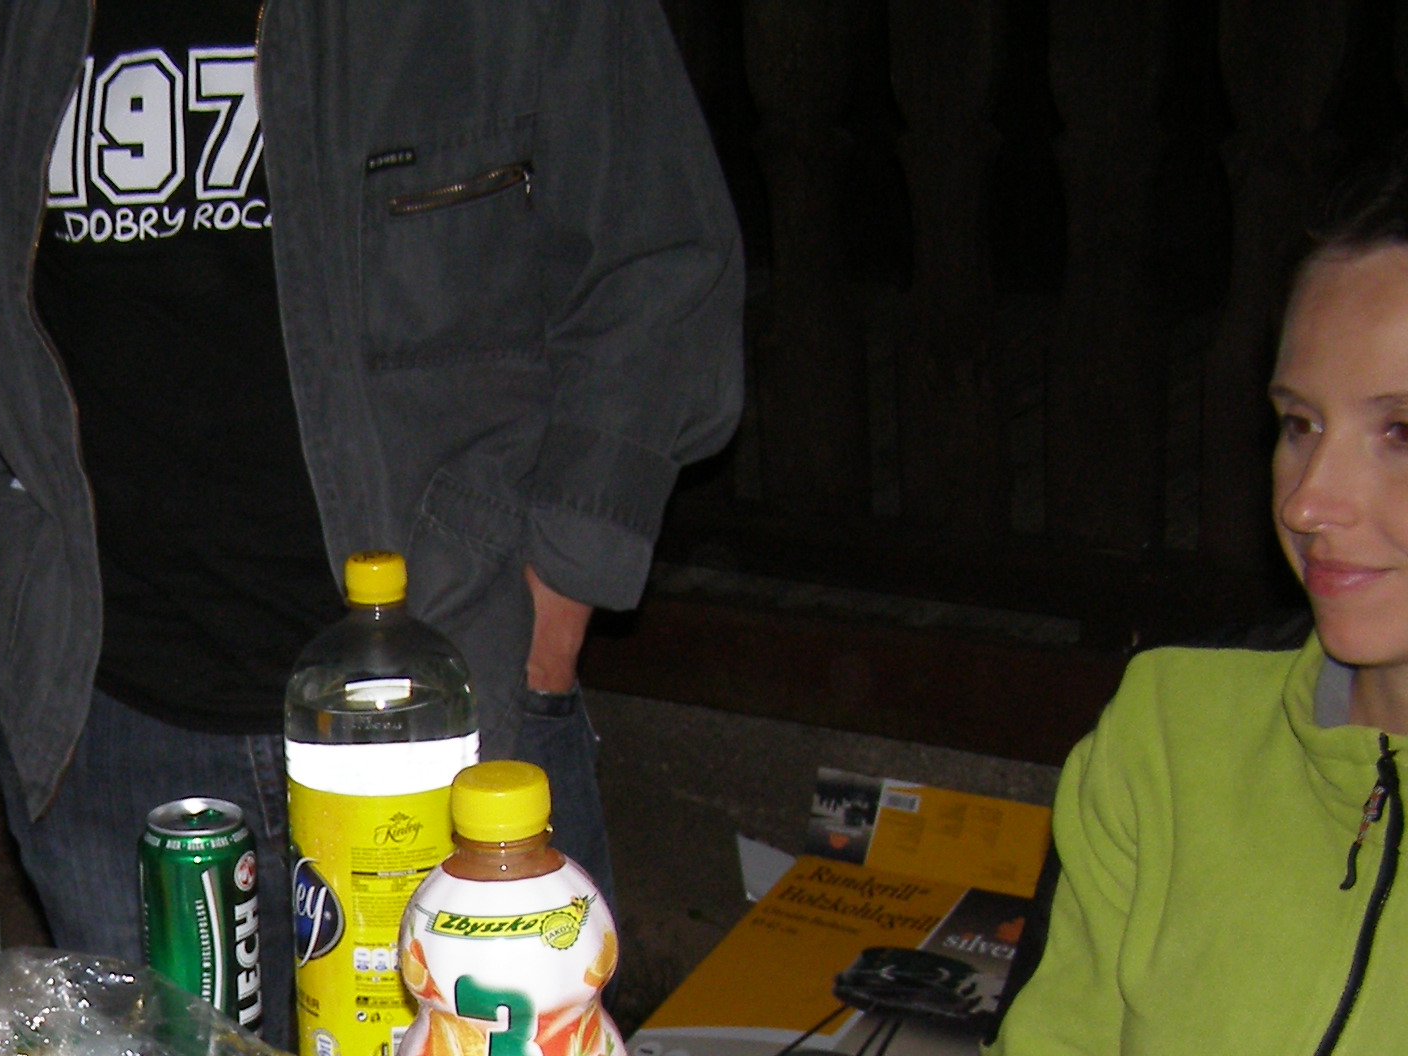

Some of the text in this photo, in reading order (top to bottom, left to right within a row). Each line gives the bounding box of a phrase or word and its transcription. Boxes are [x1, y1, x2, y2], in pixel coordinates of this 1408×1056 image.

[46, 48, 265, 208] 197
[193, 200, 272, 231] ROC
[234, 897, 263, 1026] LECH
[441, 915, 538, 936] Zbyszko
